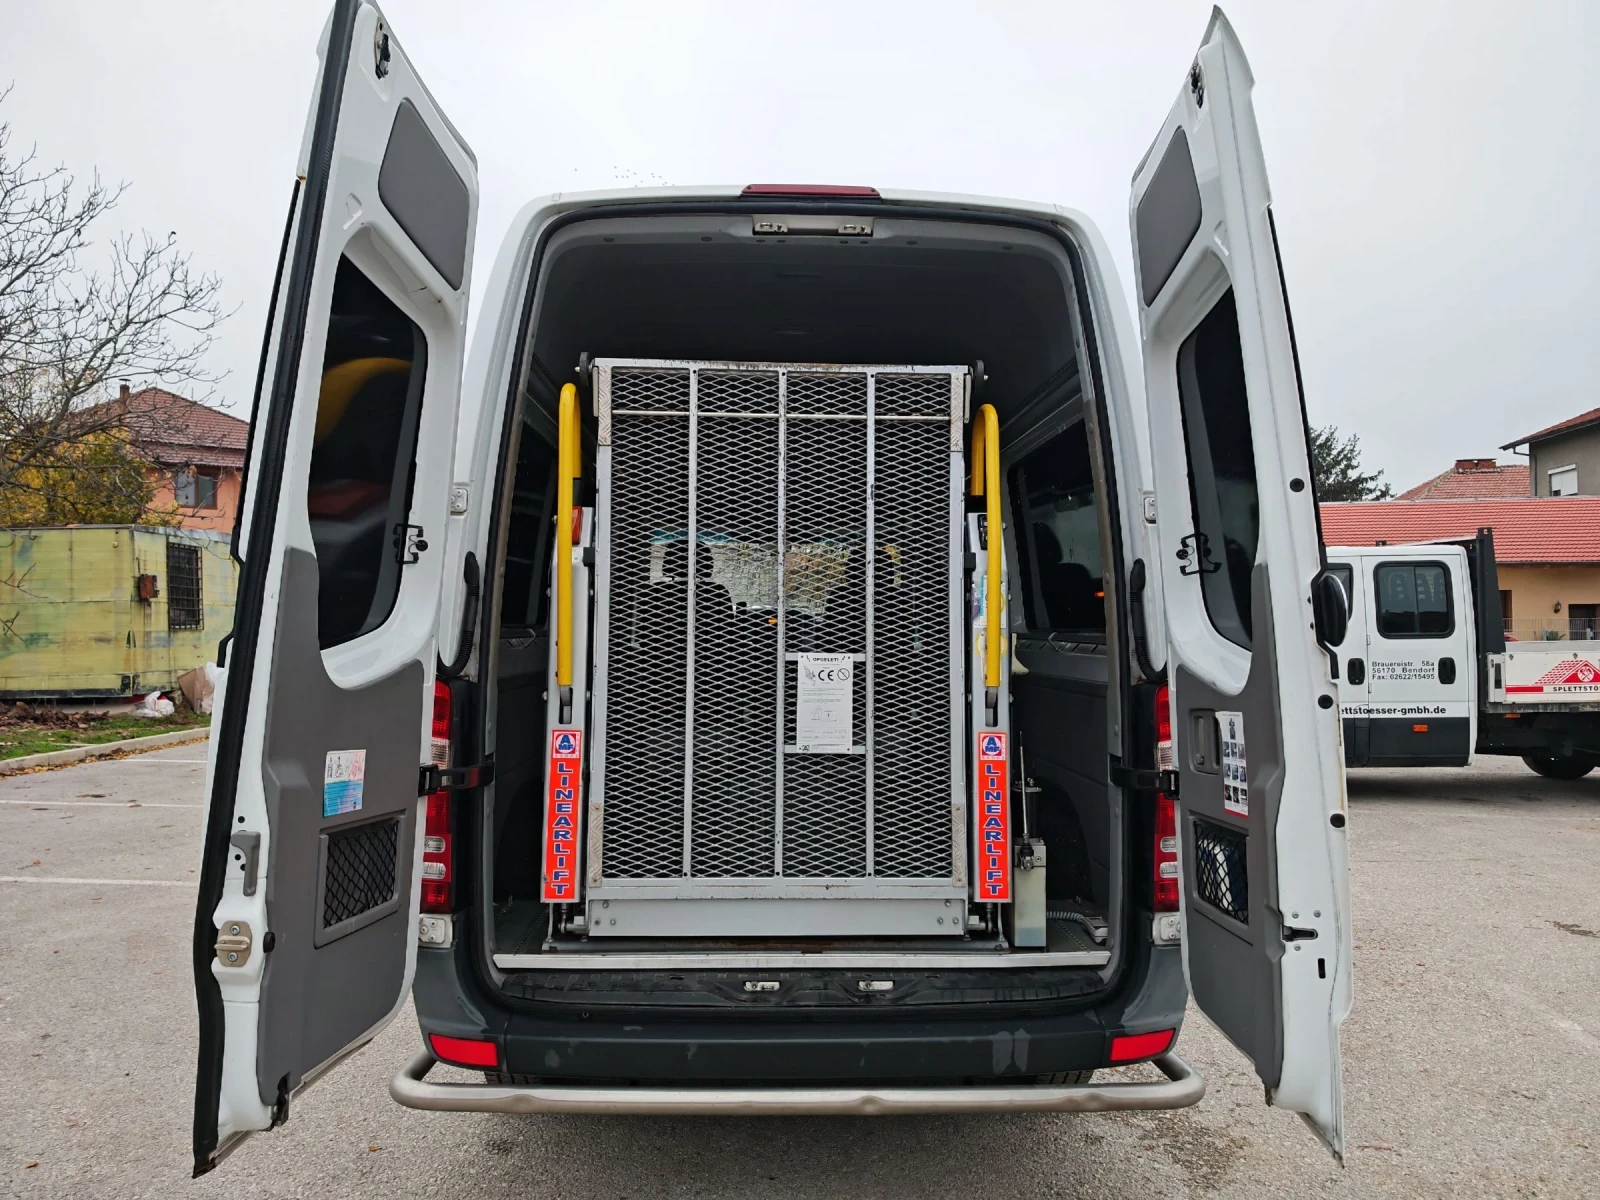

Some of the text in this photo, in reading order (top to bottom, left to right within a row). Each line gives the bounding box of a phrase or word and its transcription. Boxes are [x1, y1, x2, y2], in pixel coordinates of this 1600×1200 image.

[818, 669, 834, 682] CE
[552, 762, 573, 896] LINEARLIFT
[983, 763, 1004, 896] LINEARLIFT
